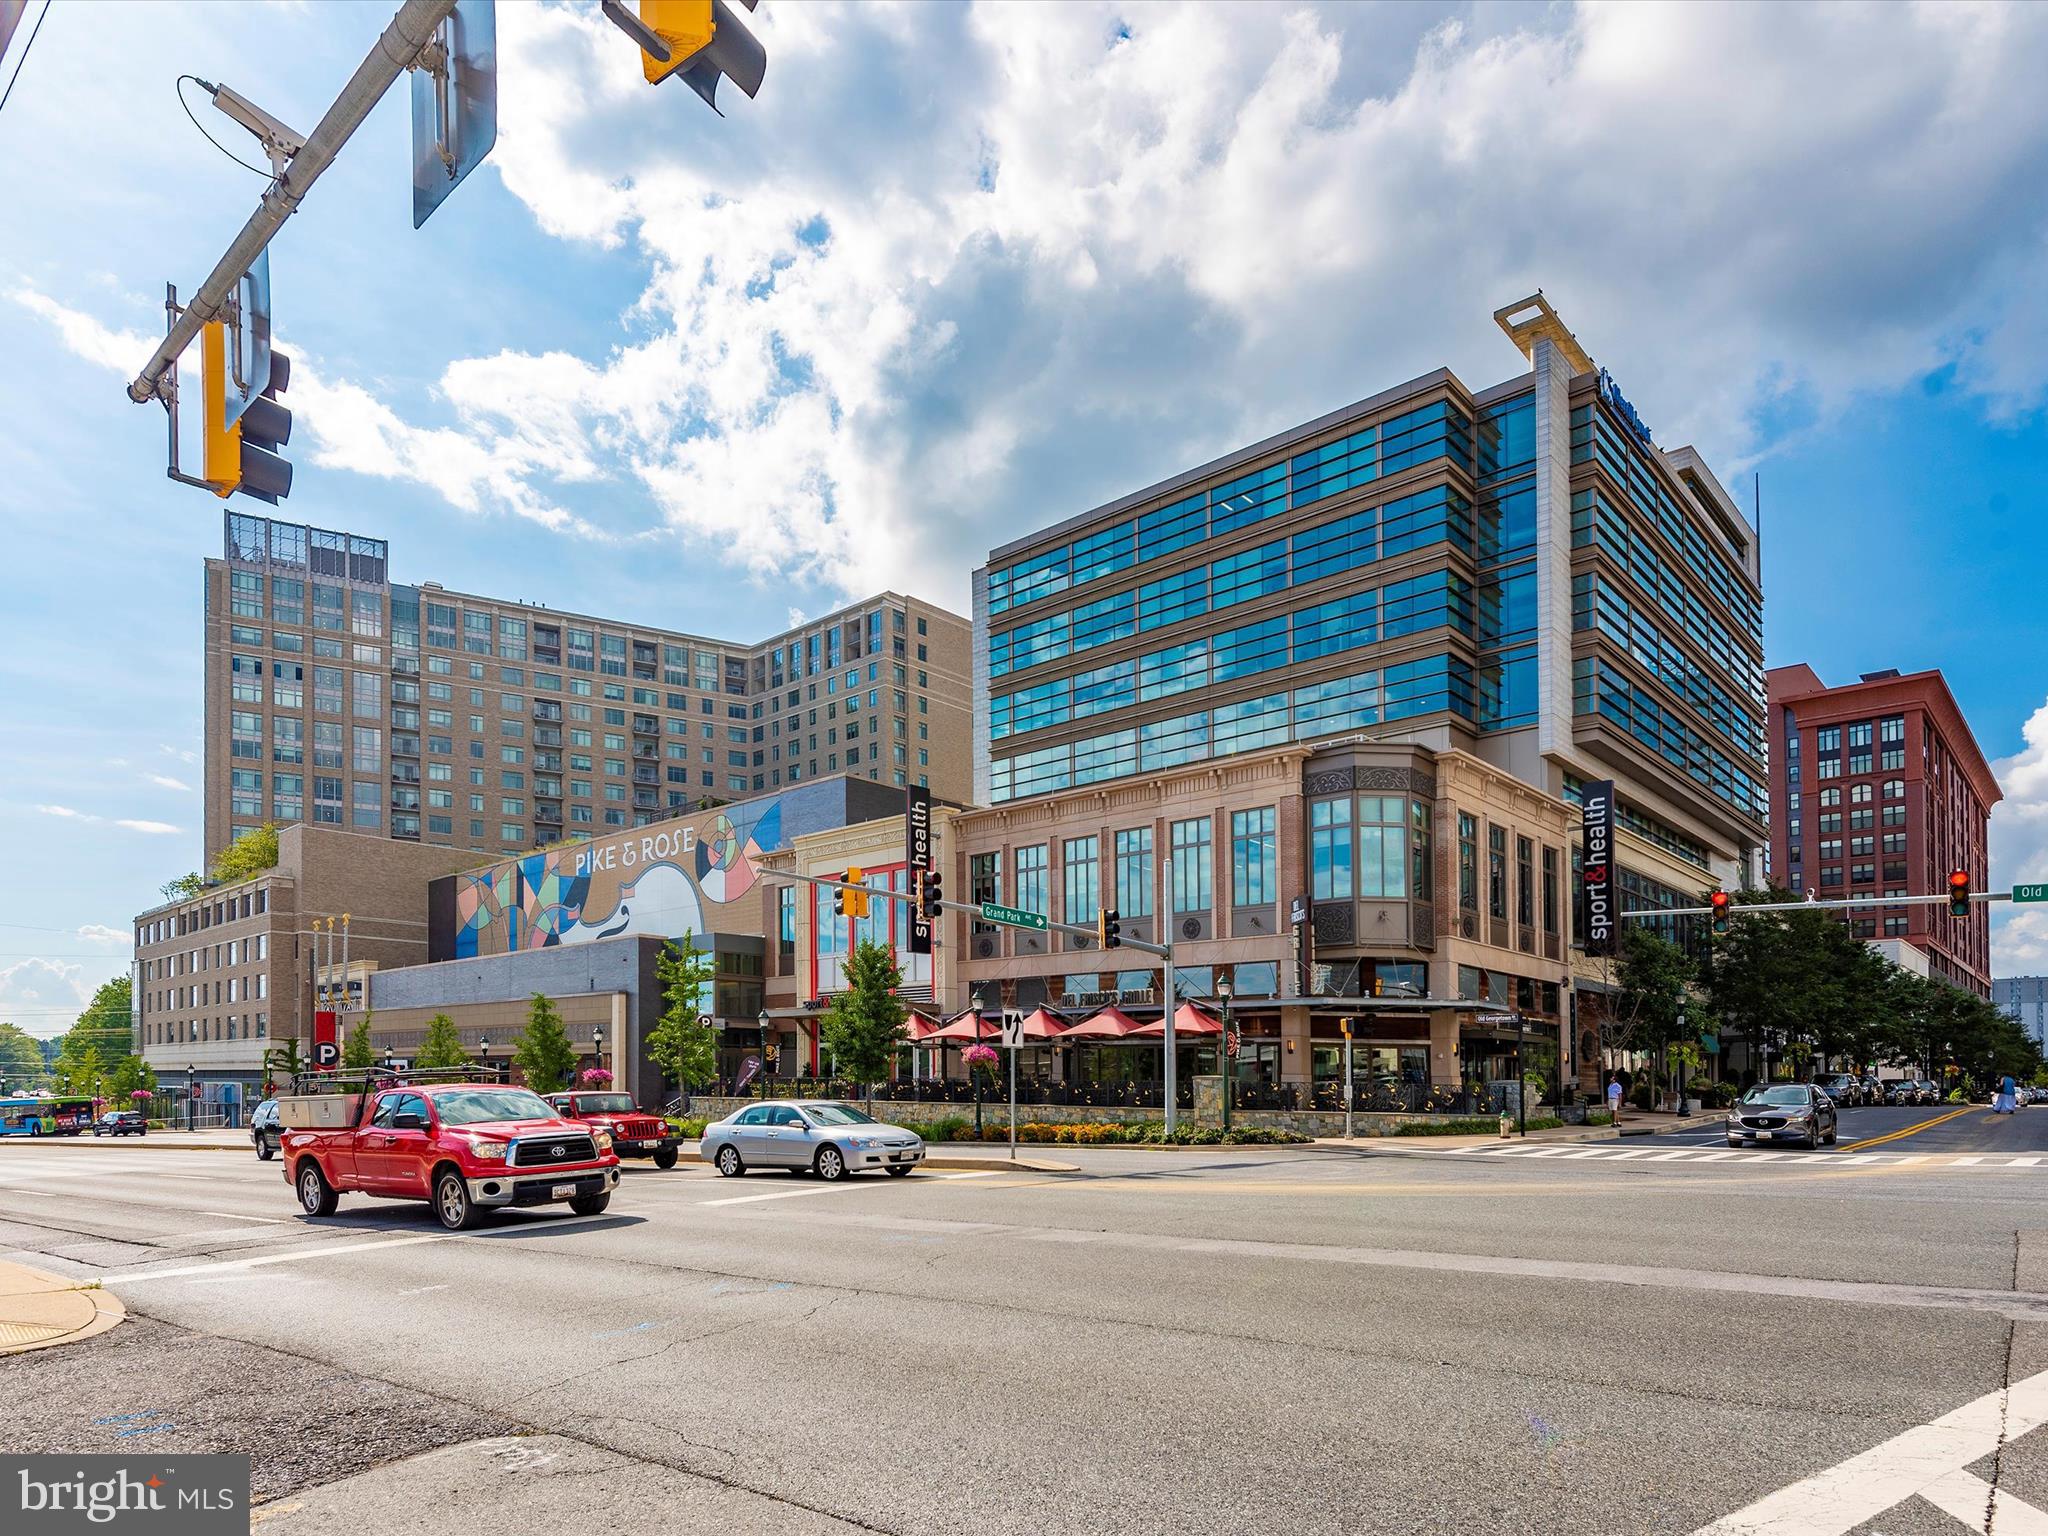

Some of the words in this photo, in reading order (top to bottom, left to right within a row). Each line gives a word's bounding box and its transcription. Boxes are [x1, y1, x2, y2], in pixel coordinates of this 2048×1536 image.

[575, 845, 617, 876] PIKE
[622, 841, 637, 867] &
[641, 826, 695, 861] ROSE
[1584, 797, 1613, 940] sport&health
[2021, 886, 2042, 898] Old
[985, 906, 1005, 919] Grand
[1006, 910, 1021, 922] Park
[1062, 992, 1077, 1009] DEL
[1080, 989, 1120, 1008] FRISCO'S
[1121, 988, 1154, 1006] GRILLE
[320, 1045, 336, 1064] P
